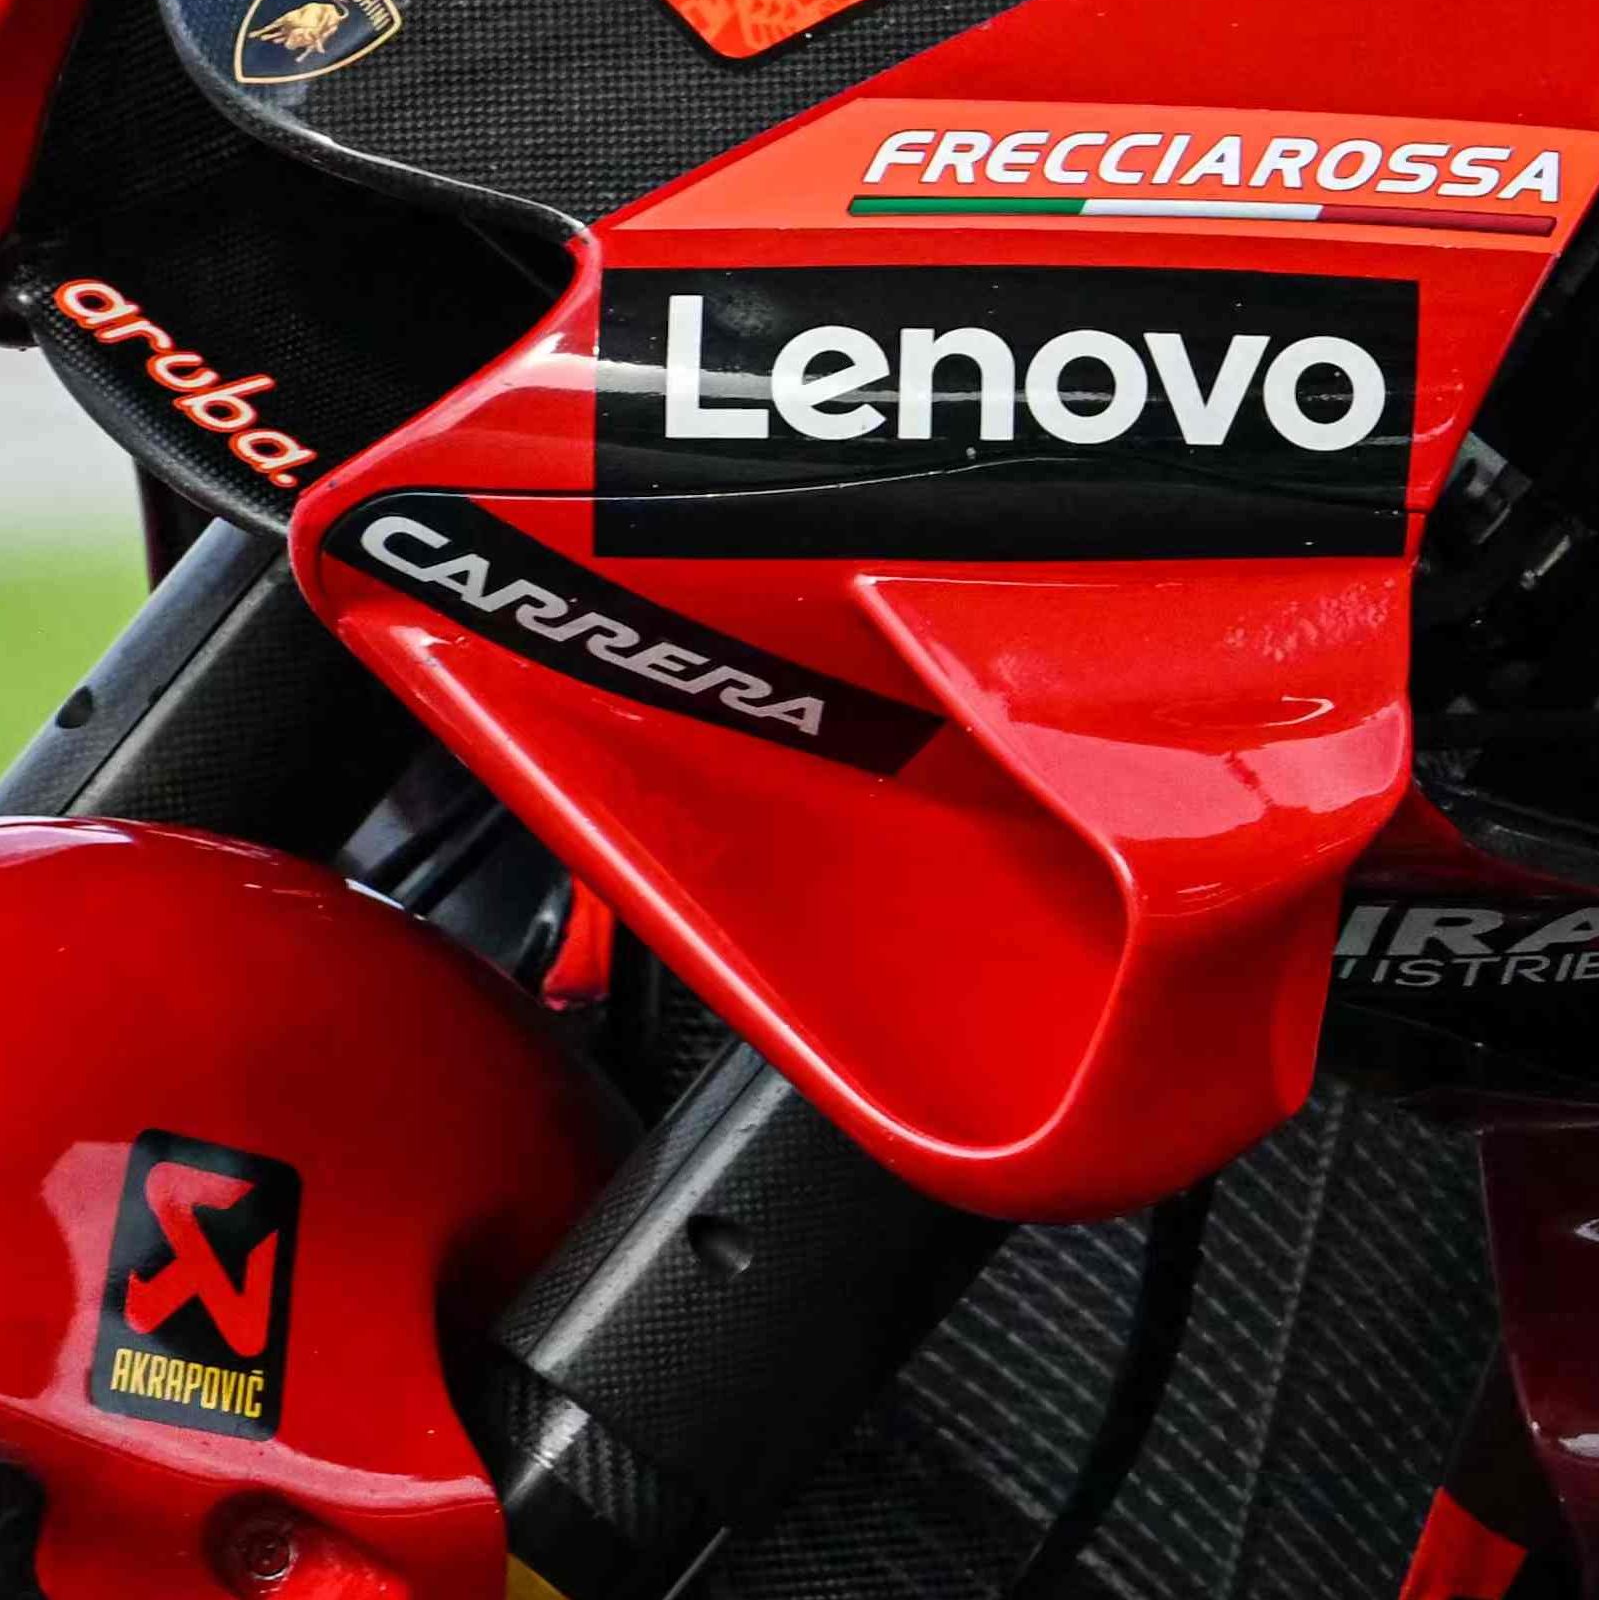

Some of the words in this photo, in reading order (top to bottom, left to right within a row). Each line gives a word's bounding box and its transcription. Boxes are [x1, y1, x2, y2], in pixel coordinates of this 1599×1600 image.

[861, 128, 1564, 202] FRECCIAROSSA
[664, 294, 1387, 453] Lenovo
[360, 514, 825, 737] CARRERA
